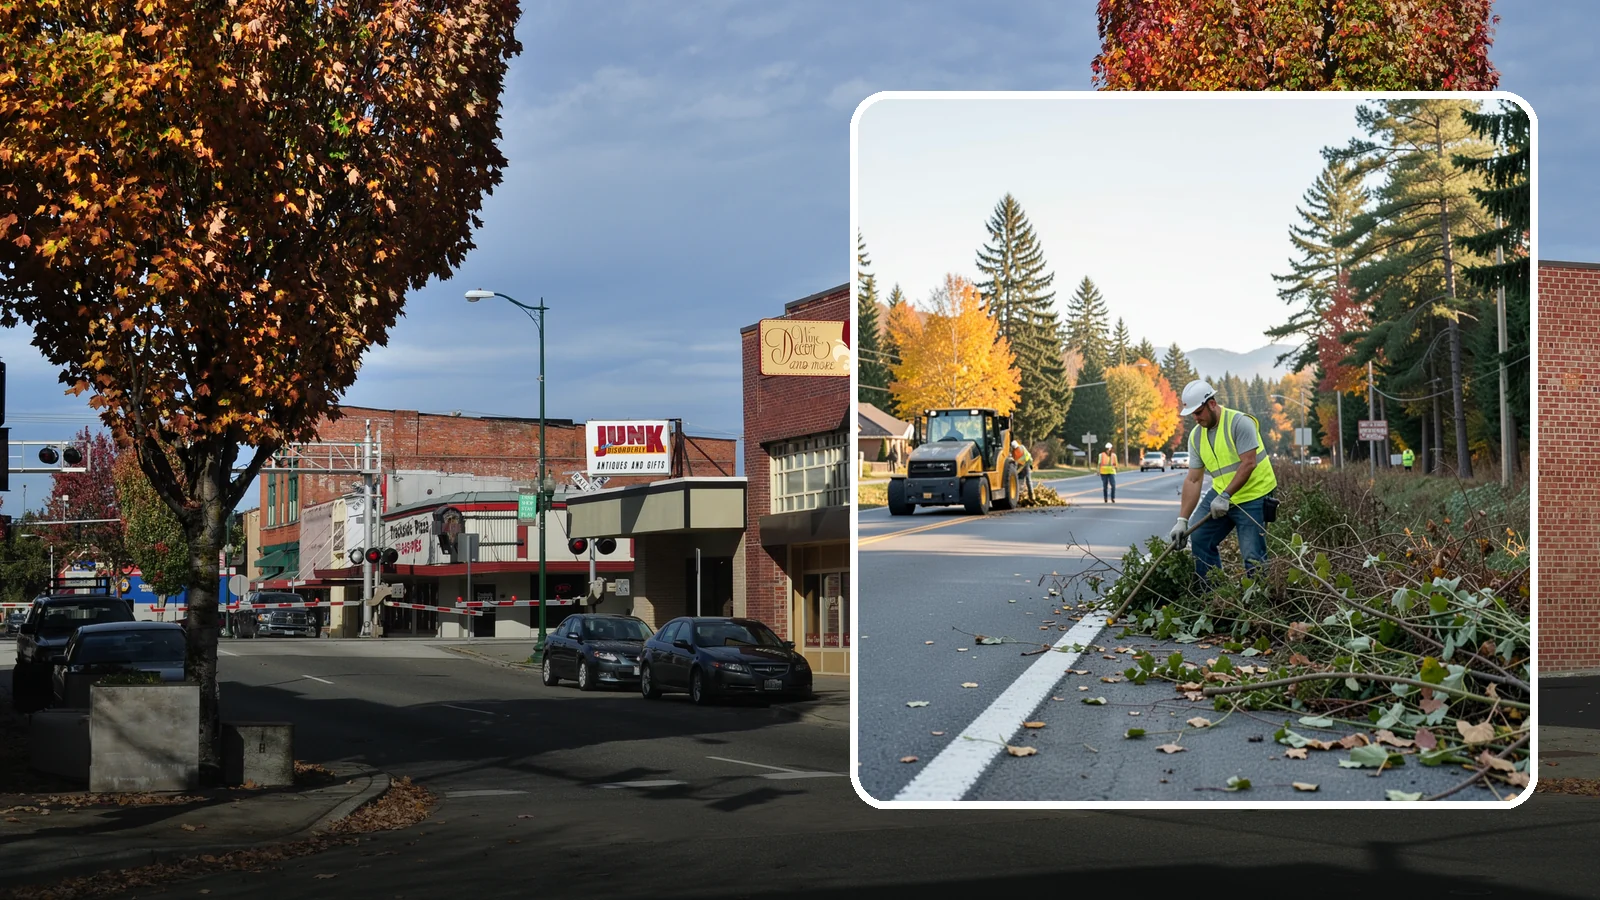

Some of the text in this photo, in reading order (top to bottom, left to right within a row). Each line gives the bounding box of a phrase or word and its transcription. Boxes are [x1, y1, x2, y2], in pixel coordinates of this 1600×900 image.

[595, 425, 664, 457] JUNK
[607, 446, 646, 454] DISORDERLY
[596, 460, 665, 470] ANTIQUES AND GIFTS
